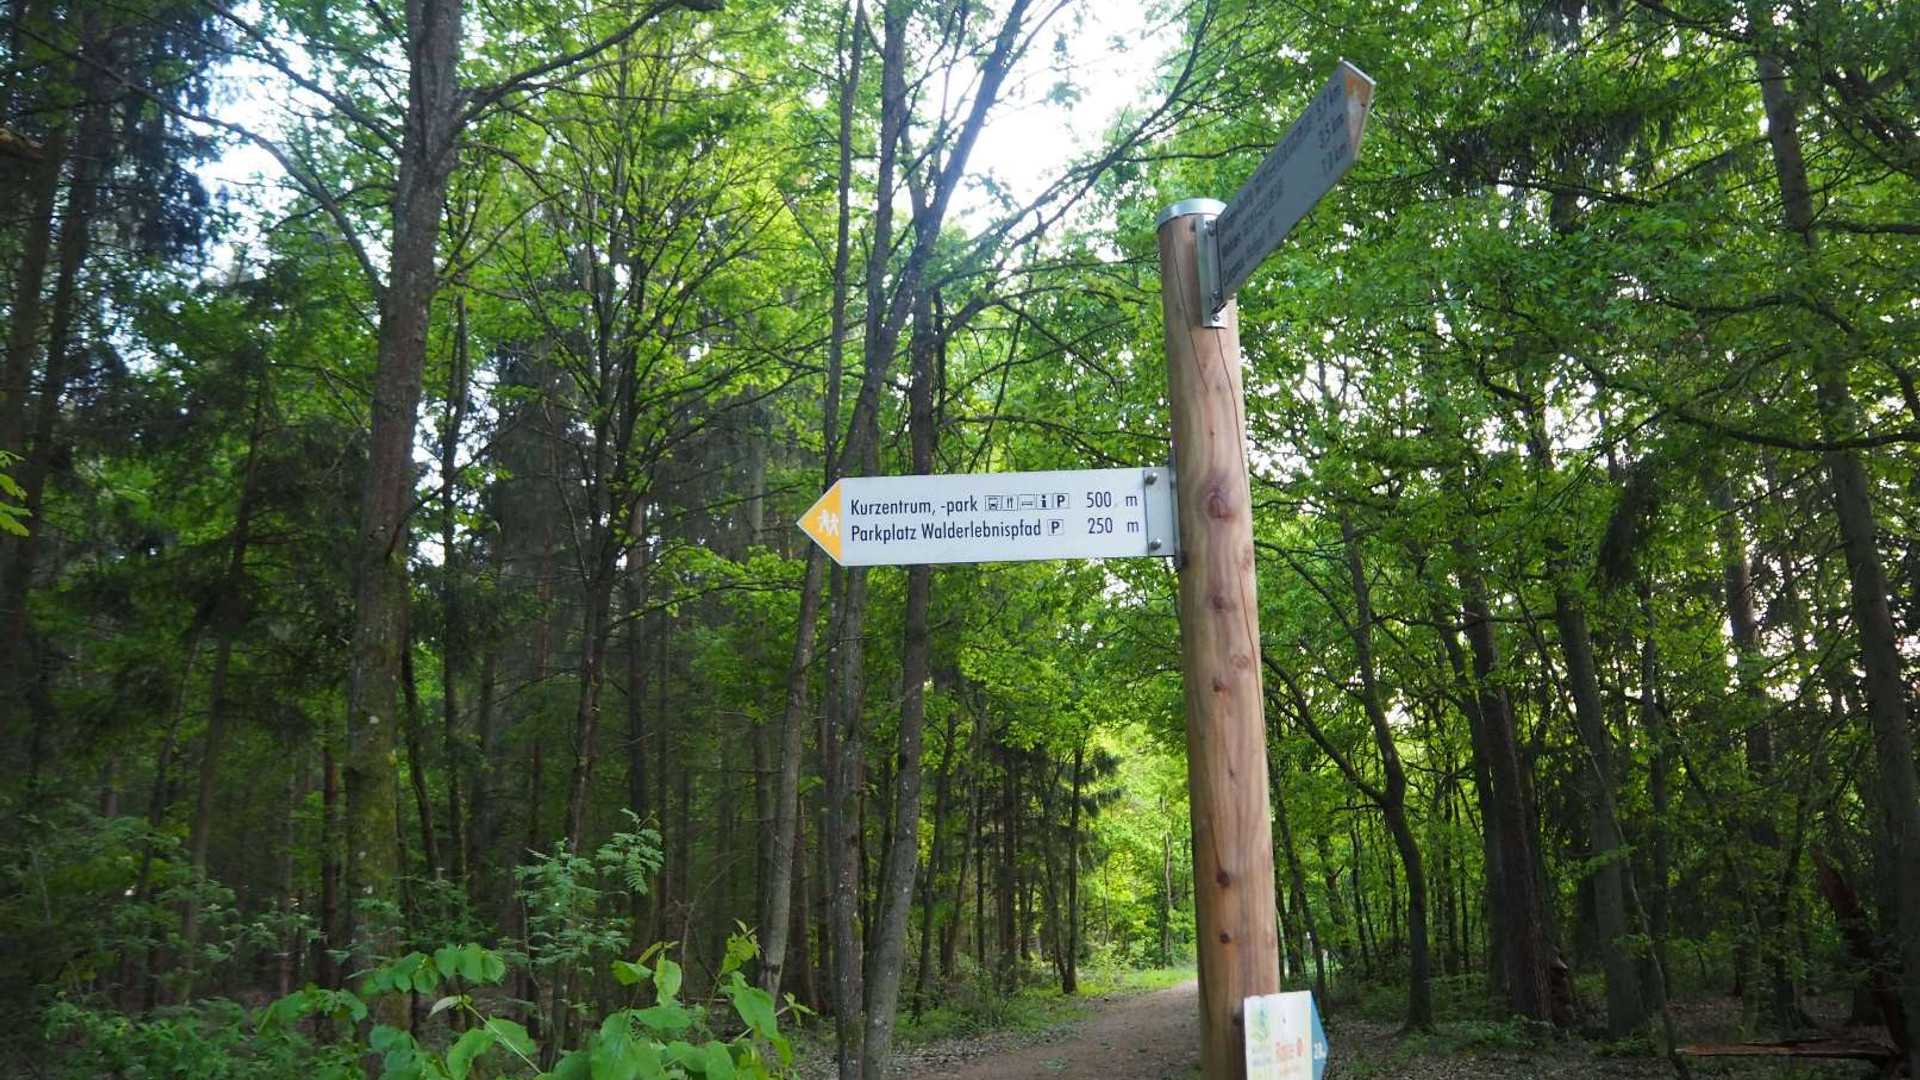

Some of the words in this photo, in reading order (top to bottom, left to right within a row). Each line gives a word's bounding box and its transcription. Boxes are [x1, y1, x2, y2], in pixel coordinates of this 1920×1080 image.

[851, 499, 936, 516] Kurzentrum,
[941, 494, 978, 516] -park
[1056, 494, 1065, 508] P
[1086, 491, 1112, 508] 500
[1125, 495, 1138, 507] m
[851, 523, 917, 544] Parkplatz
[921, 519, 1041, 540] Walderlebnispfad
[1051, 521, 1060, 534] P
[1087, 517, 1113, 534] 250
[1127, 520, 1140, 533] m
